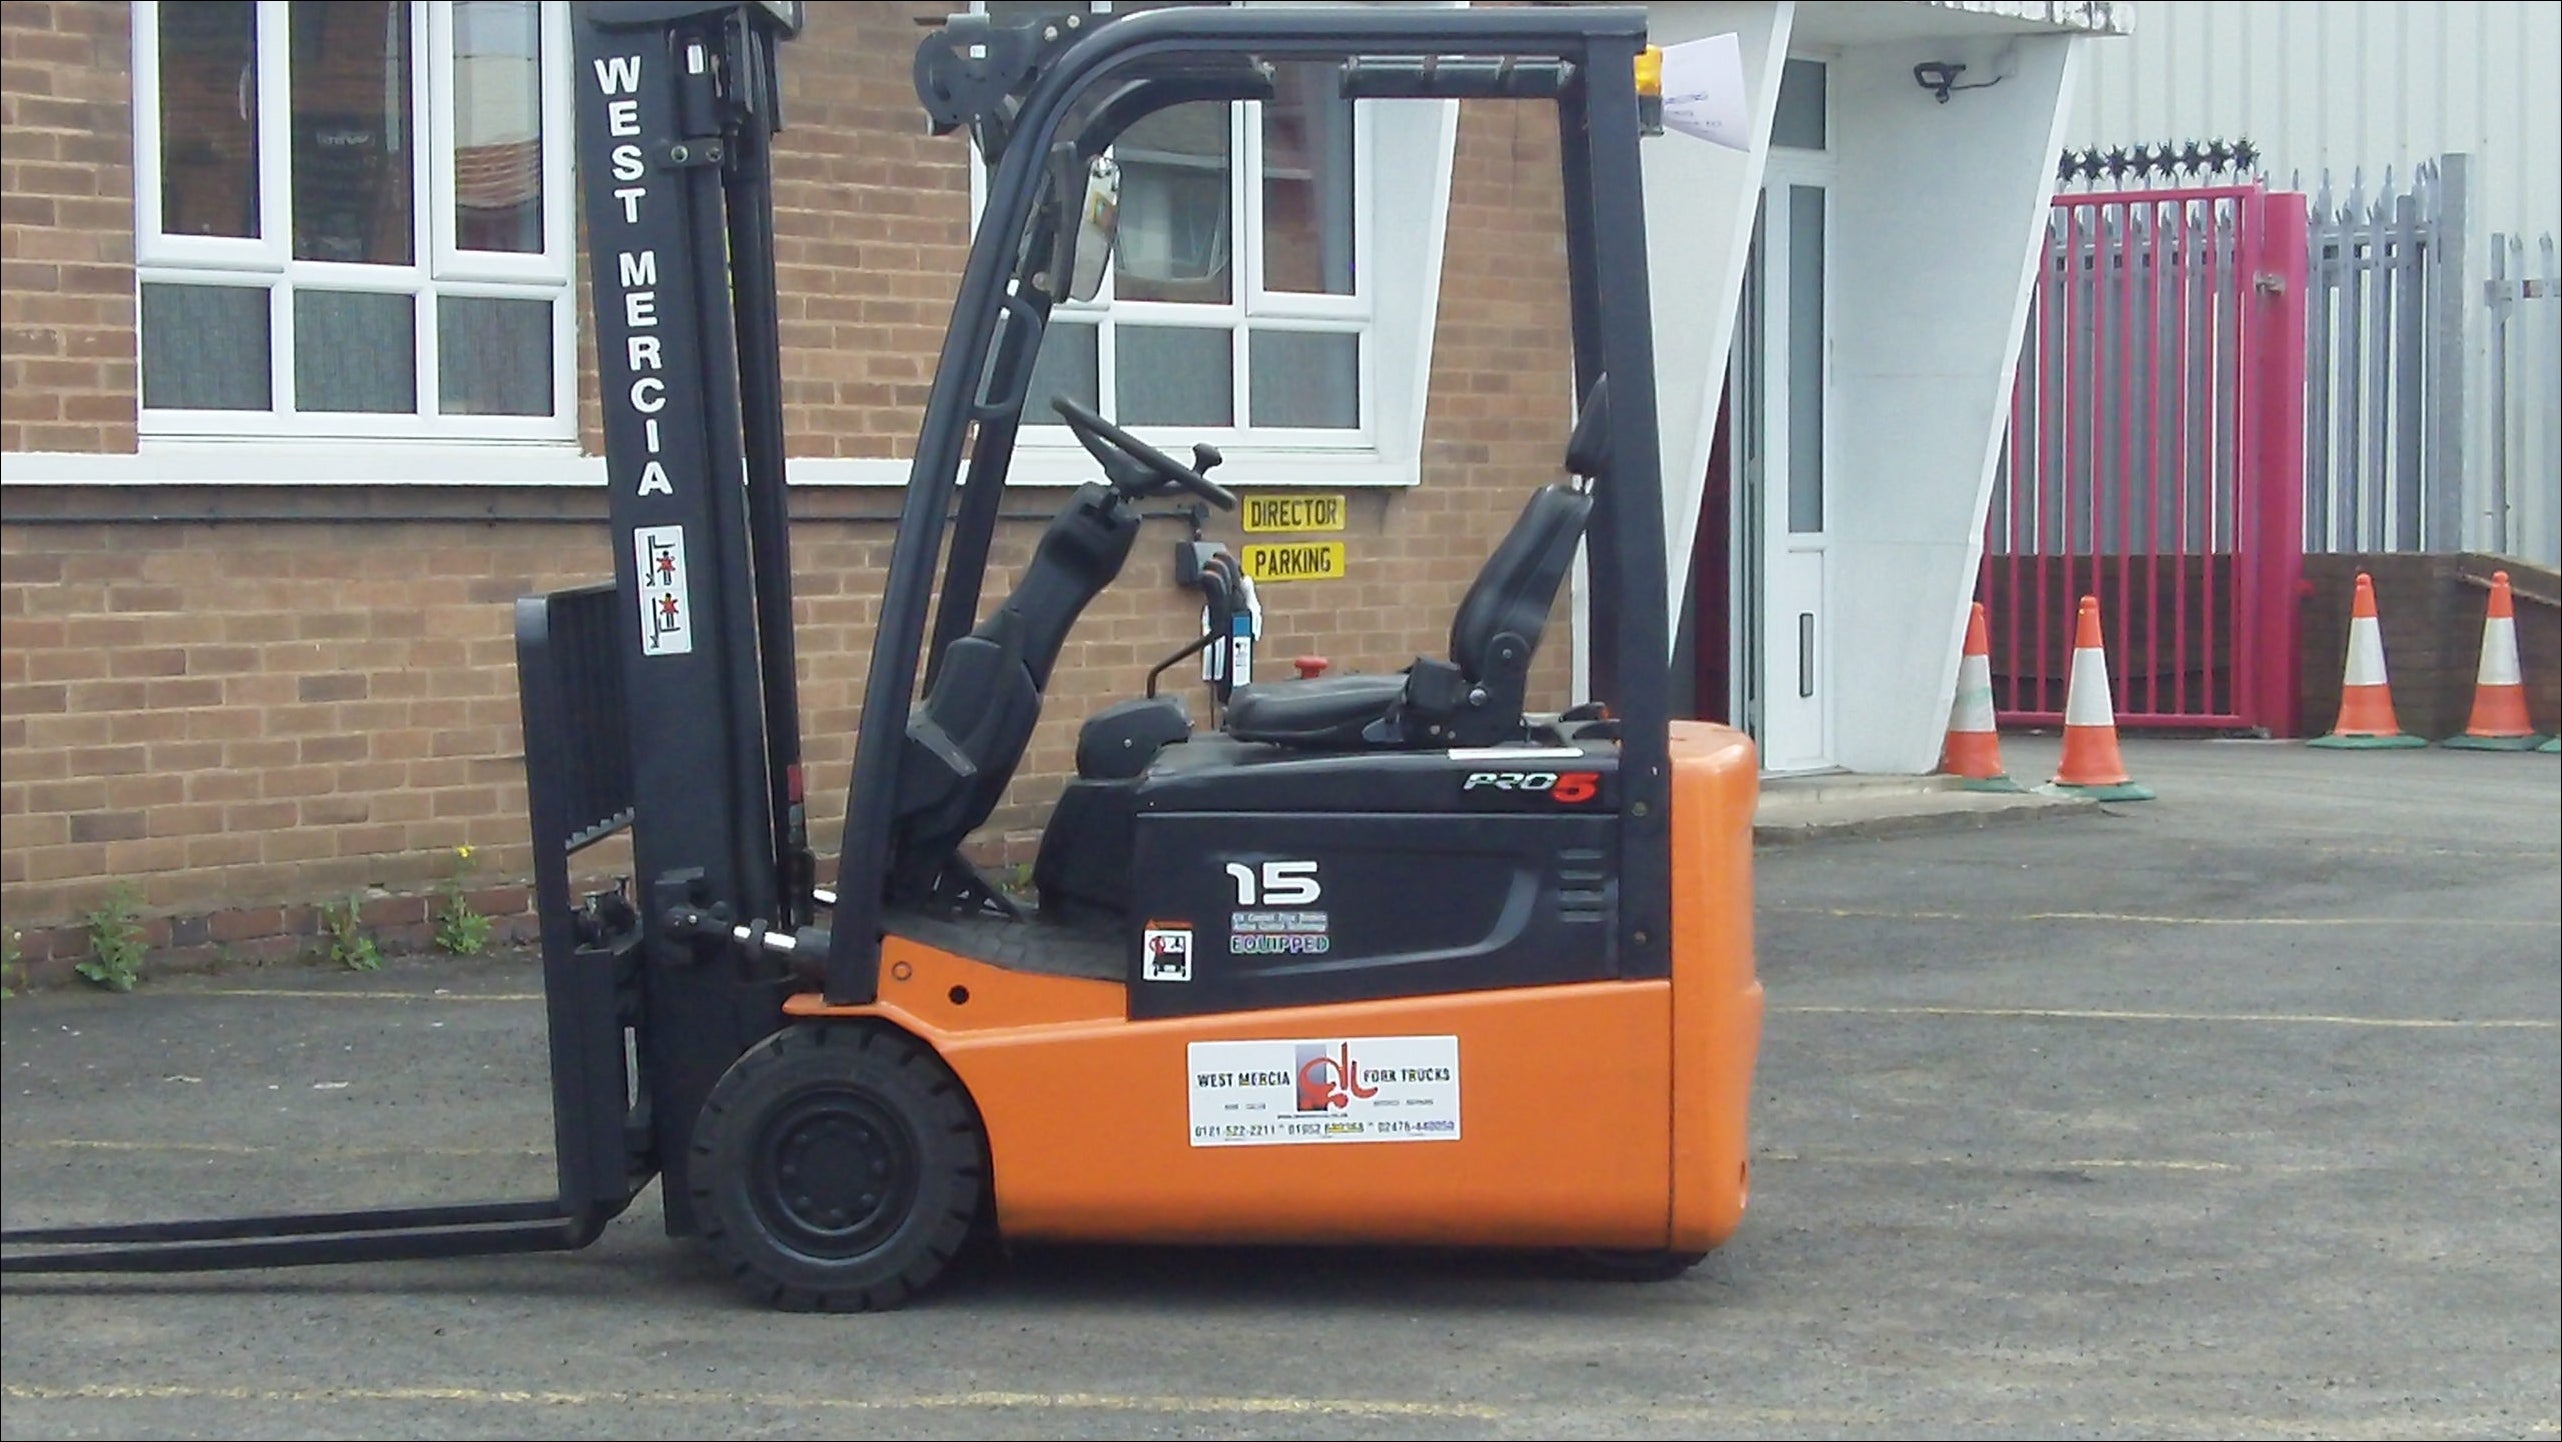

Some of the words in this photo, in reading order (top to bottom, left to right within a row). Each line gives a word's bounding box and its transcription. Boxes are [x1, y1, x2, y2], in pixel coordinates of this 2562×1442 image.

[594, 56, 647, 223] WEST
[619, 250, 673, 496] MERCIA
[1251, 499, 1337, 528] DIRECTOR
[1255, 547, 1331, 576] PARKING
[1226, 861, 1321, 905] 15
[1230, 934, 1329, 954] EQUIPPED
[1197, 1072, 1233, 1088] WEST
[1239, 1070, 1290, 1087] MERCIA
[1364, 1069, 1397, 1083] FORK
[1402, 1067, 1451, 1082] TRUCKS
